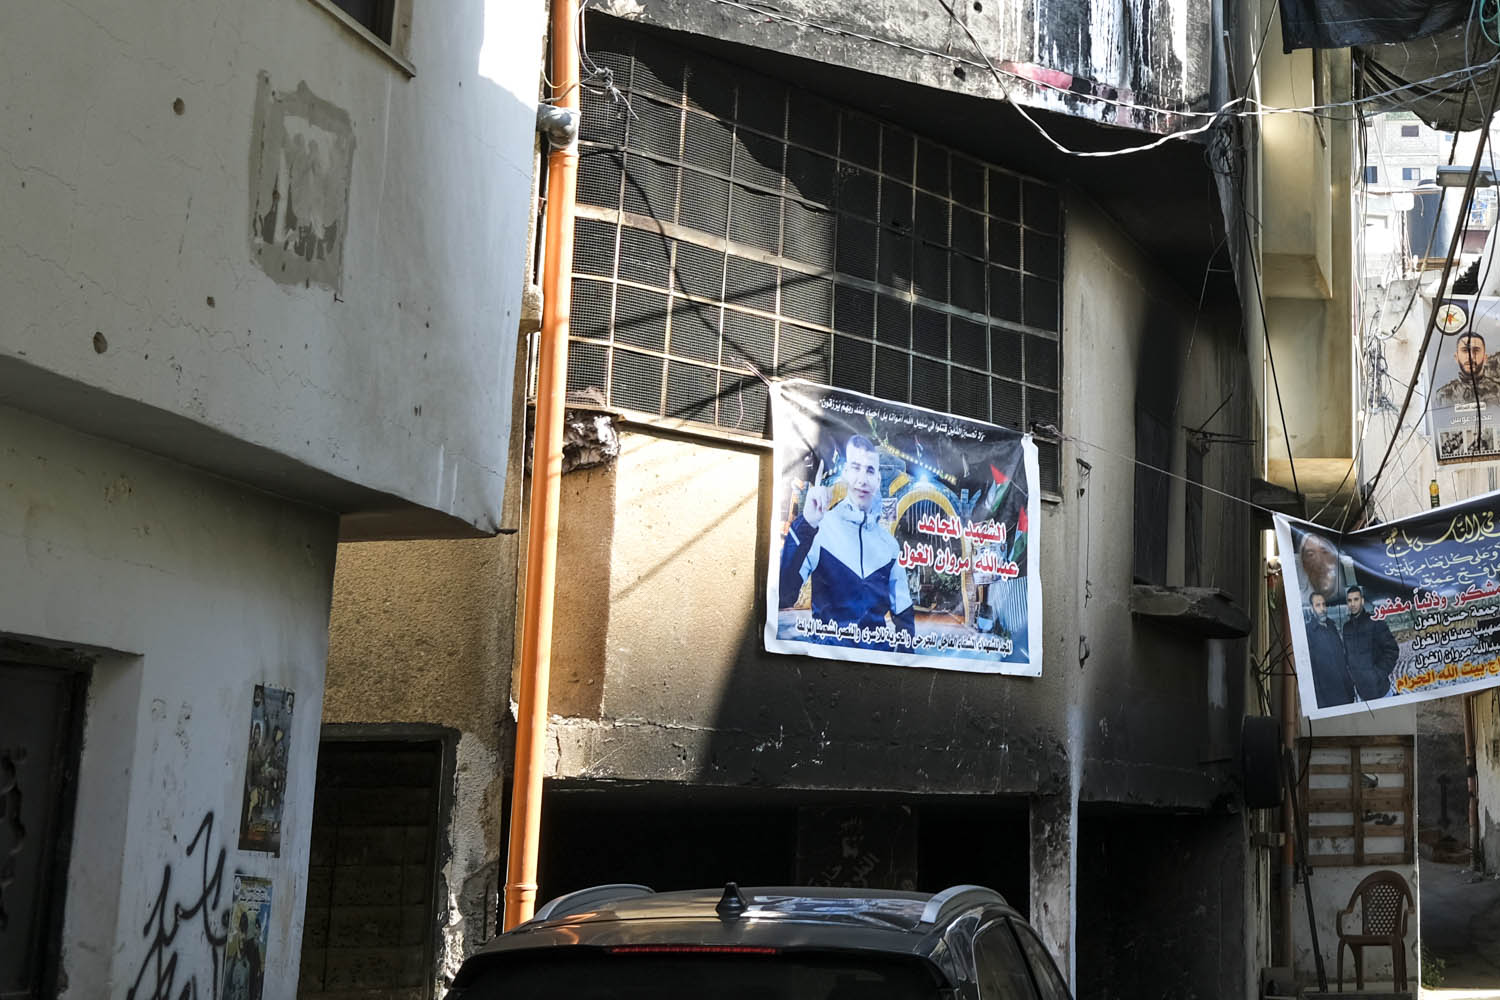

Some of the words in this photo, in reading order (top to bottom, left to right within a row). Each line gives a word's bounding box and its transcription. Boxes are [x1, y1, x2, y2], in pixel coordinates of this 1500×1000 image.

[918, 513, 961, 541] المجاهد
[964, 519, 1006, 544] الشهيد
[898, 541, 933, 569] الغول
[934, 547, 970, 575] مروان
[1370, 597, 1412, 620] مغفور
[1471, 605, 1499, 617] جمعة
[1414, 613, 1441, 630] الغول
[1443, 610, 1469, 626] حسن
[1412, 632, 1440, 650] الغول
[1441, 627, 1472, 645] عدنان
[1415, 650, 1442, 668] الغول
[1444, 647, 1471, 664] مروان
[1436, 663, 1459, 678] الله
[1461, 660, 1486, 678] بيت
[1396, 669, 1436, 692] الحرام
